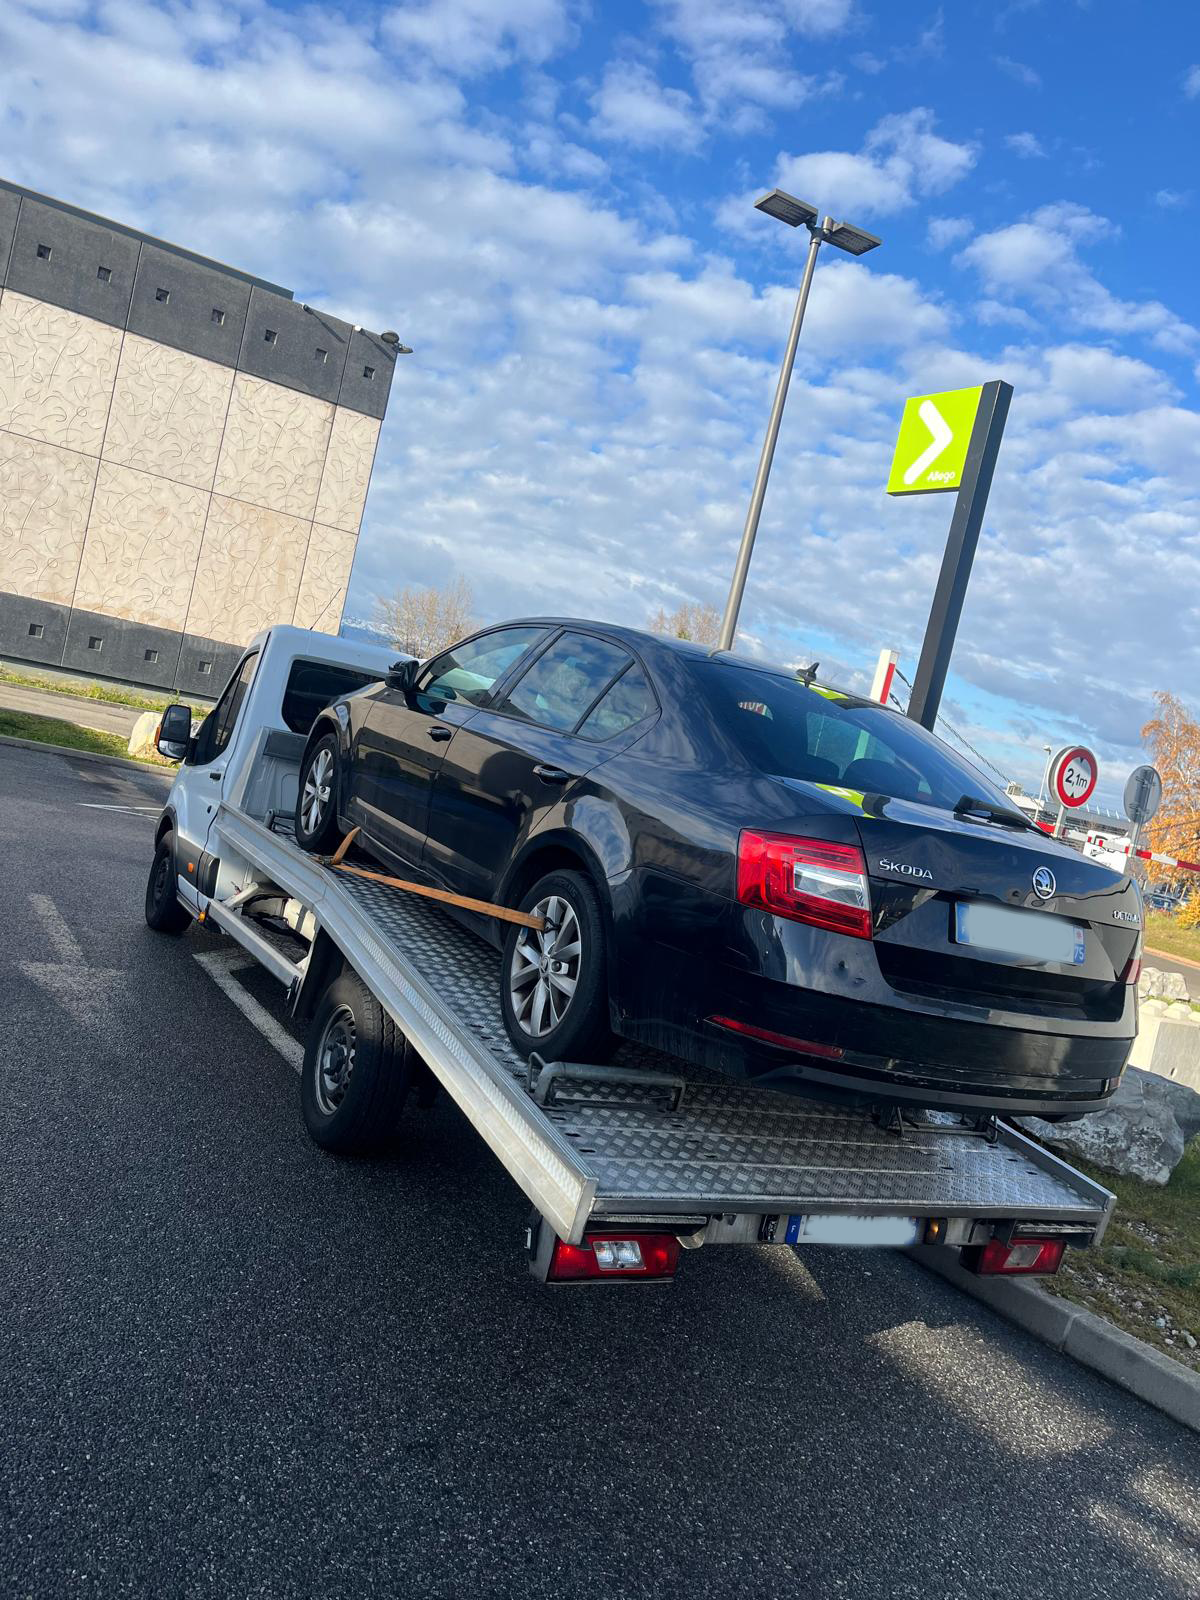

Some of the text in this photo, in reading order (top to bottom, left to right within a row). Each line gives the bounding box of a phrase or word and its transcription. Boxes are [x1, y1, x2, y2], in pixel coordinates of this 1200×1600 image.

[1065, 768, 1088, 788] 2,1m
[879, 857, 933, 880] ŠKODA
[1074, 946, 1084, 961] 75
